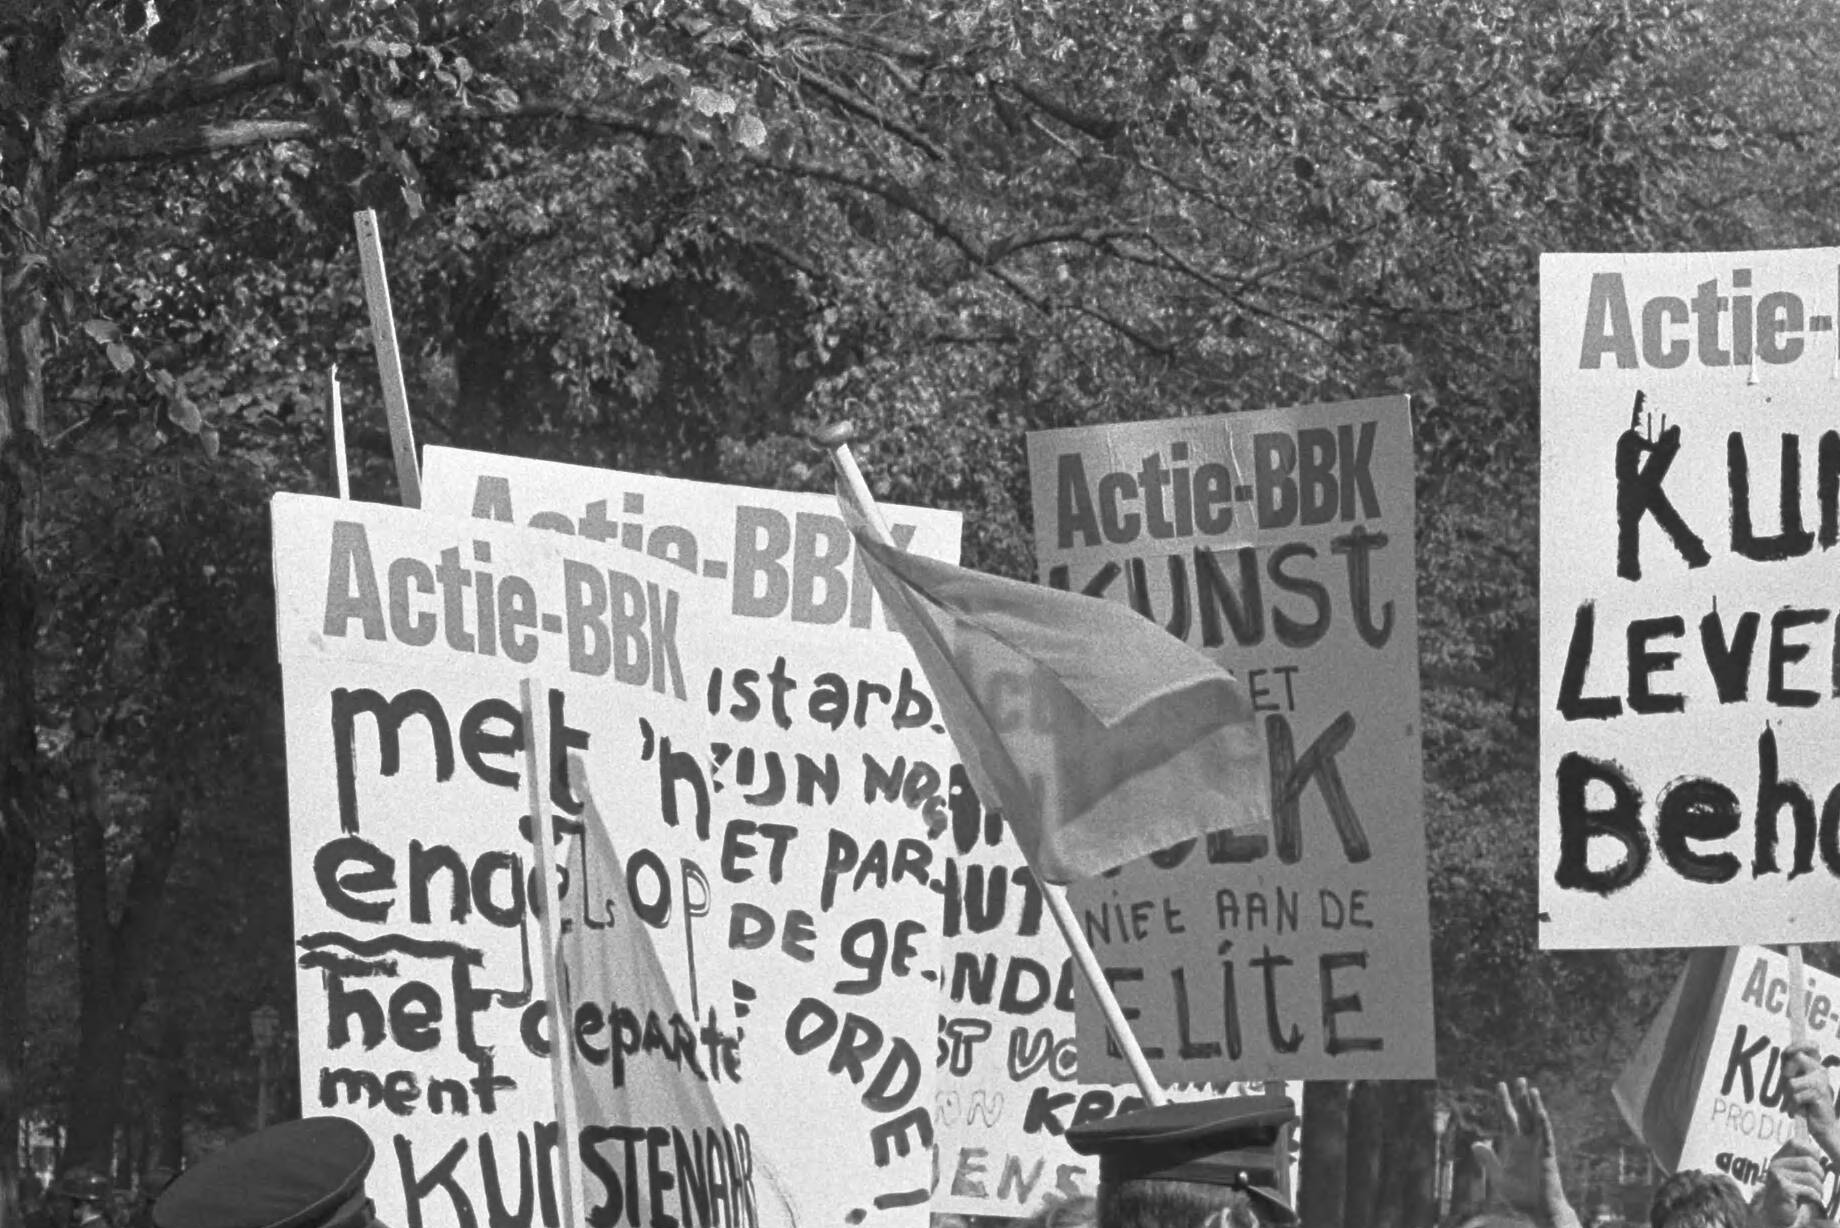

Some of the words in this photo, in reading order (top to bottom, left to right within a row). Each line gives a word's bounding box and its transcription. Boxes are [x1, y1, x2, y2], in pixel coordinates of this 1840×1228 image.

[1057, 420, 1382, 550] Actie-BBK
[323, 521, 687, 701] Actie-BBK
[331, 686, 589, 834] met
[728, 902, 818, 963] DE
[1216, 885, 1299, 935] AAN
[1320, 889, 1374, 931] DE
